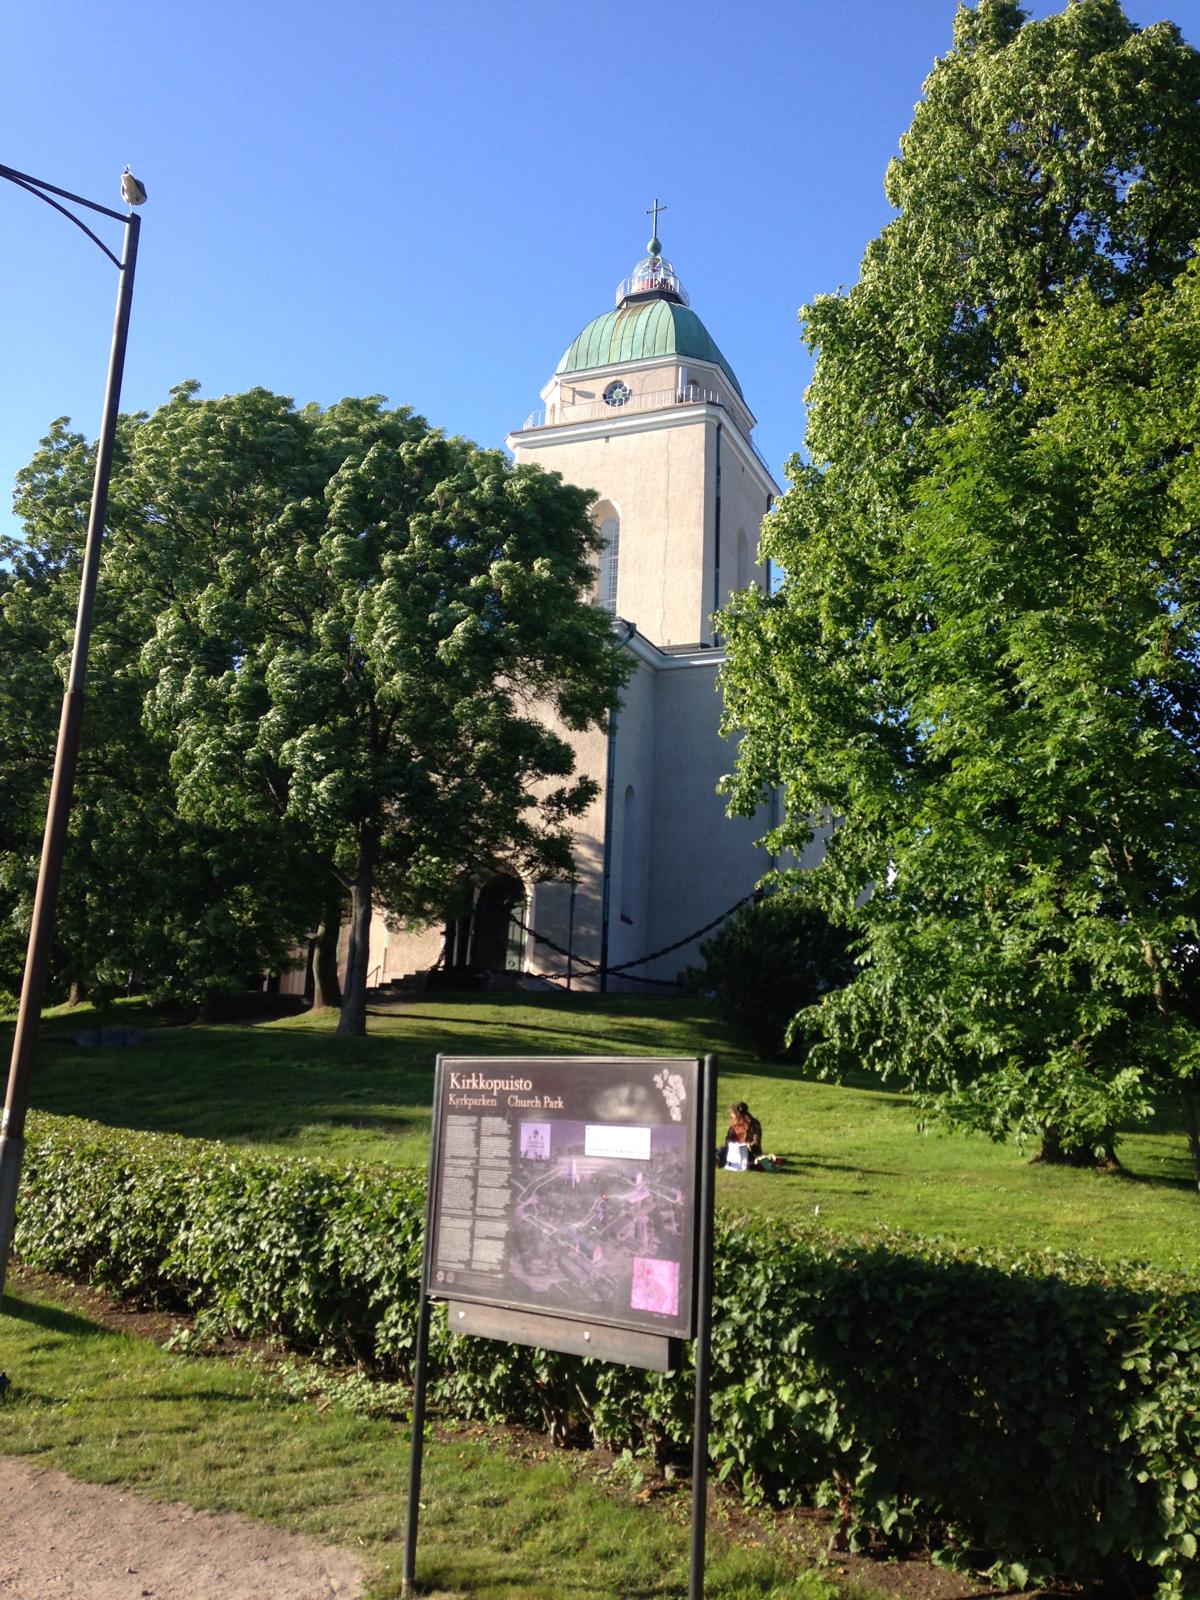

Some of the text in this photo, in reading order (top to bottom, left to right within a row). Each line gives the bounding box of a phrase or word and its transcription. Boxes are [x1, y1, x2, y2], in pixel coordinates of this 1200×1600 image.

[449, 1072, 533, 1096] Kirkkopuisto
[448, 1094, 497, 1109] Kyrkparken
[507, 1095, 564, 1109] Church Park
